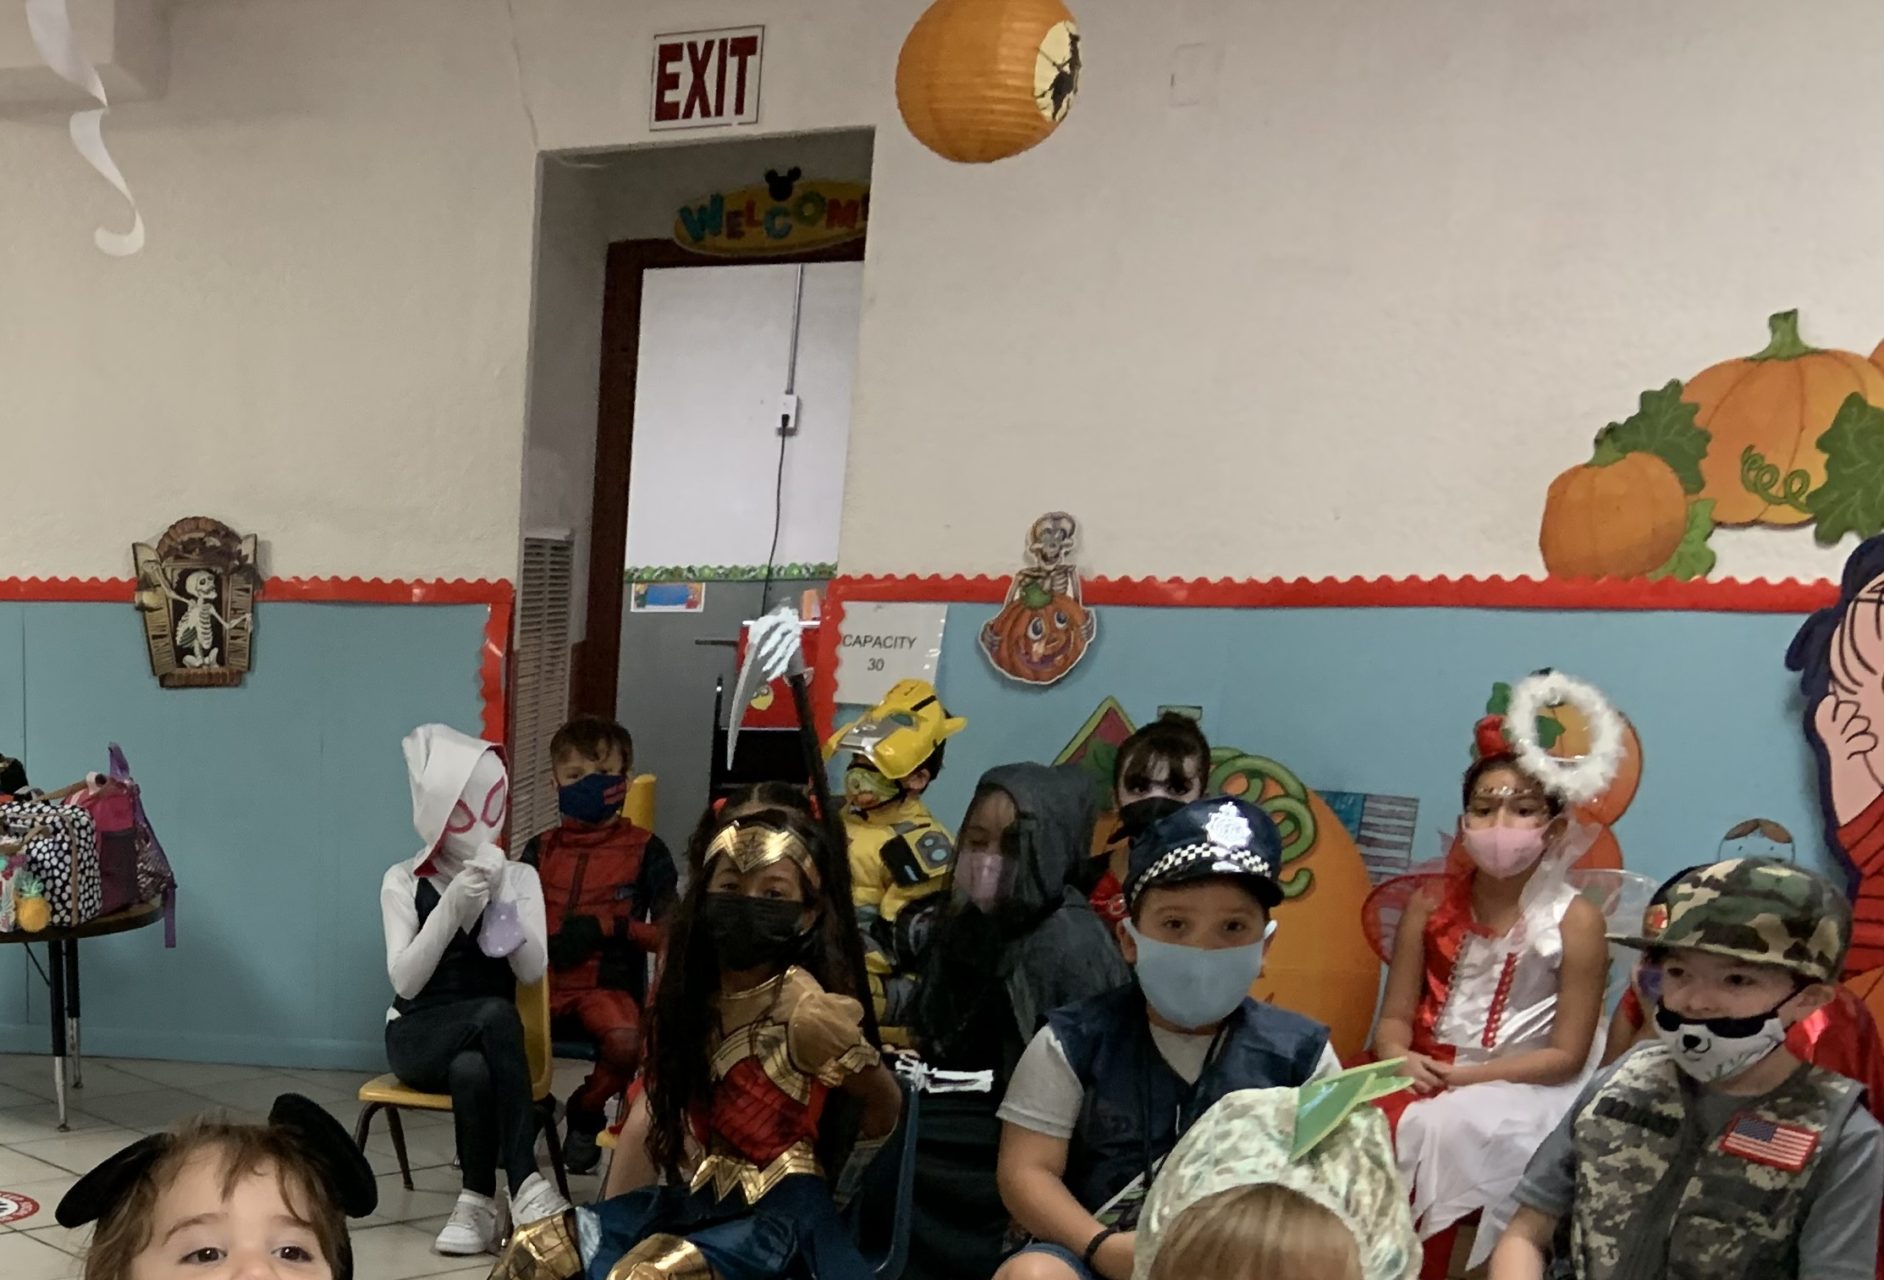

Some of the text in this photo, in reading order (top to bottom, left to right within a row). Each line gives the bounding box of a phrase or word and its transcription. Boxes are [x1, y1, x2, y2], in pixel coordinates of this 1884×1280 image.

[655, 35, 758, 122] EXIT
[842, 633, 917, 650] CAPACITY
[867, 657, 885, 672] 30
